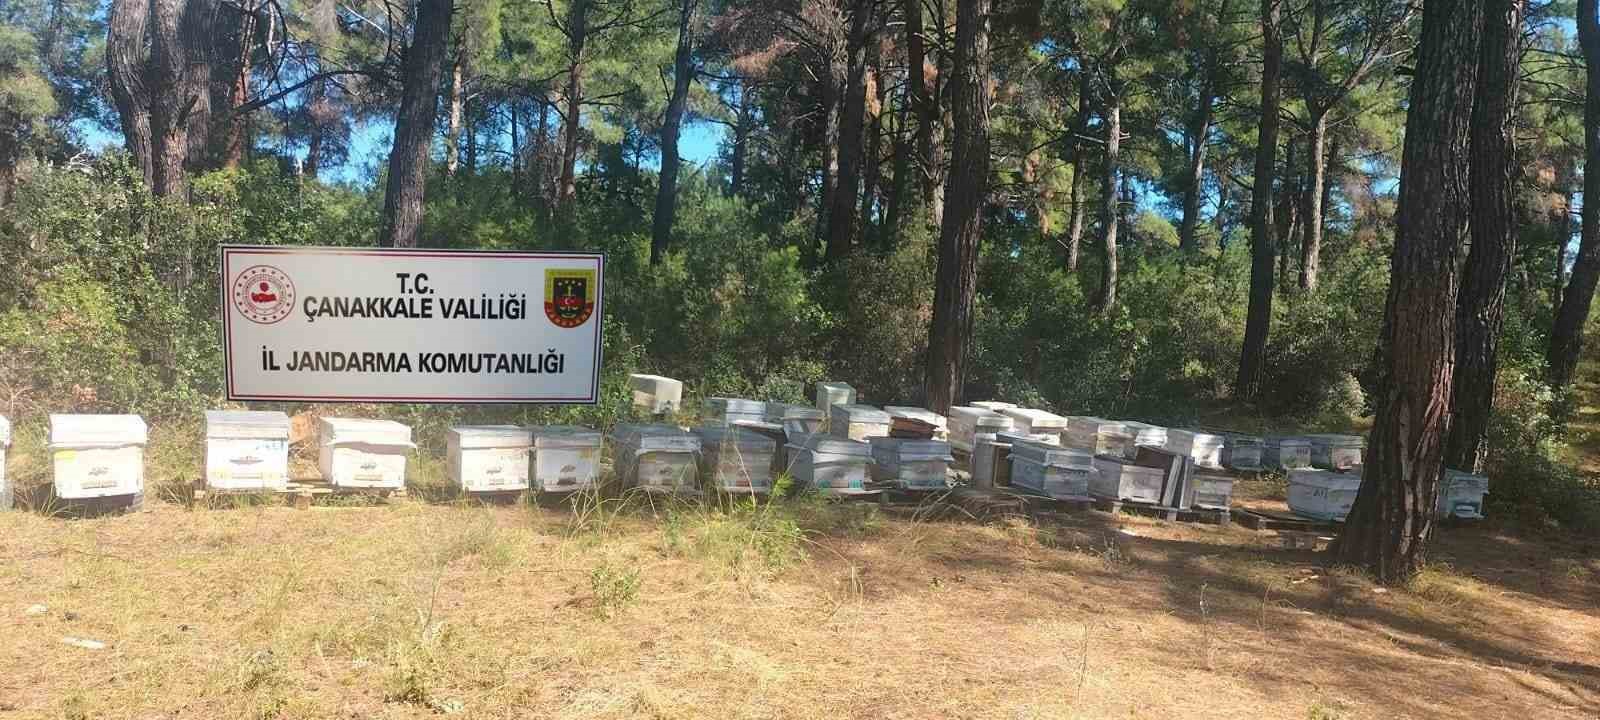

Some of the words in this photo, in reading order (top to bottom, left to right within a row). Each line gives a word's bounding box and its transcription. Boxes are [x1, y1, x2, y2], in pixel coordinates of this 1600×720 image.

[396, 272, 435, 295] T.C.
[303, 296, 433, 323] ÇANAKKALE
[439, 293, 527, 320] VALİLİĞİ
[262, 345, 281, 371] İL
[286, 351, 413, 373] JANDARMA
[418, 348, 565, 374] KOMUTANLIĞI
